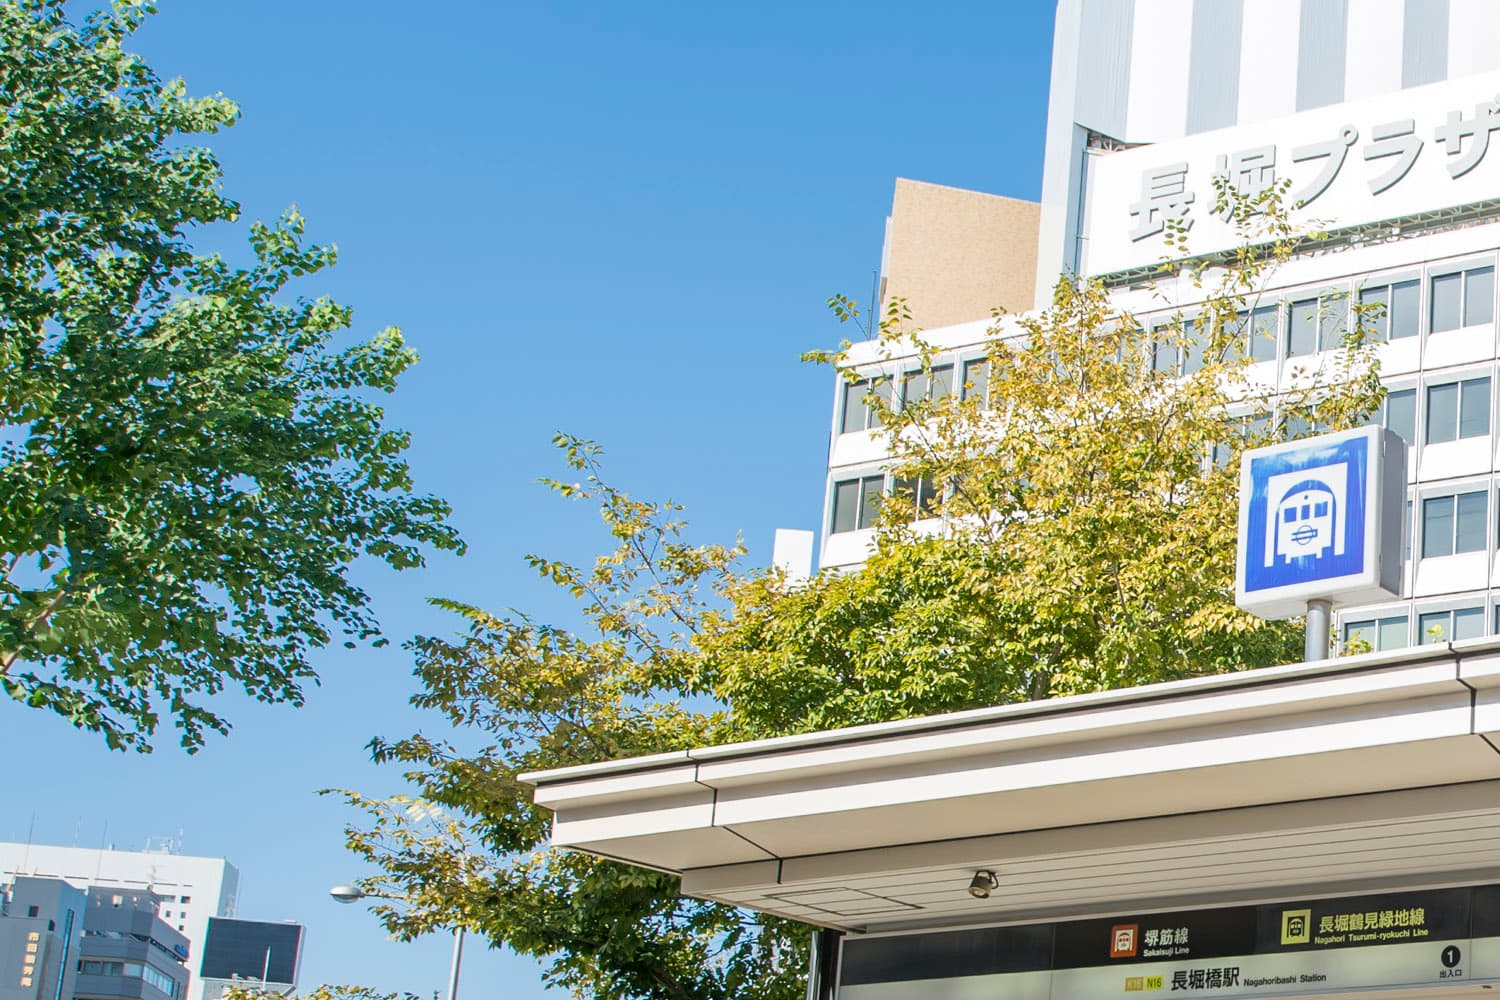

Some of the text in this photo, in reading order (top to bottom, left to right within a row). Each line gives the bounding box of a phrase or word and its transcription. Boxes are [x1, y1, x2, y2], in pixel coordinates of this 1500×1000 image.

[1319, 908, 1425, 934] 長堀鶴見緑地線
[1144, 927, 1189, 946] 堺筋線
[1314, 928, 1428, 945] Nagahori Tsurumi-ryokuchi Line
[1143, 946, 1190, 958] Sakaisuji Line
[1171, 967, 1240, 992] 長堀橋駅
[1243, 973, 1327, 988] Nagahoribashi Station
[1440, 969, 1462, 978] 出入口
[1146, 977, 1162, 988] N16
